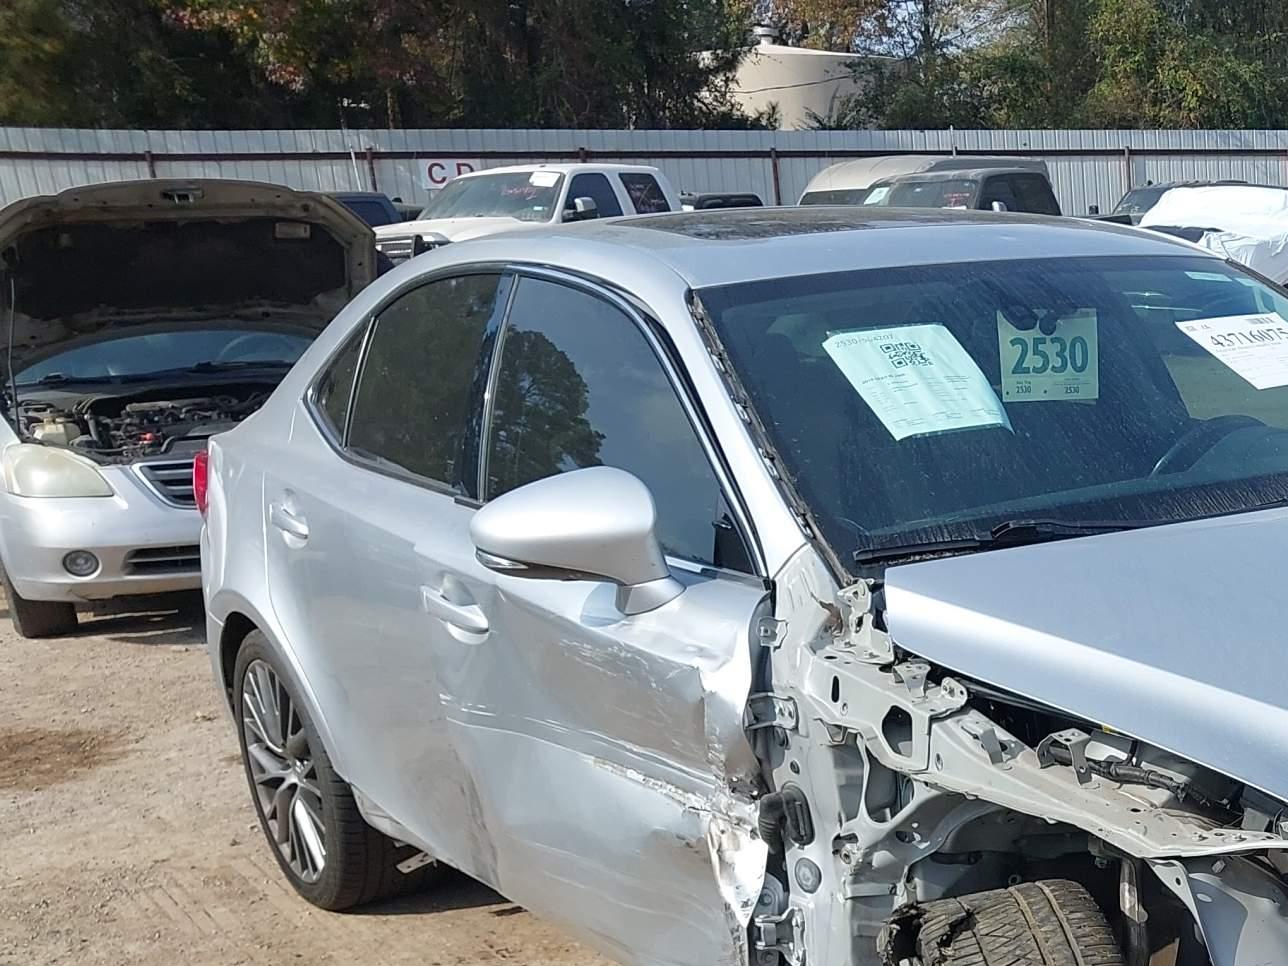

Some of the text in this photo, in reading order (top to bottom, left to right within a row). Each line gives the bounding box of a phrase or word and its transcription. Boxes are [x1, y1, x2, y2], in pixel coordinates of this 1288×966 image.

[427, 162, 447, 185] C
[1009, 335, 1089, 374] 2530
[1016, 385, 1032, 394] 2530
